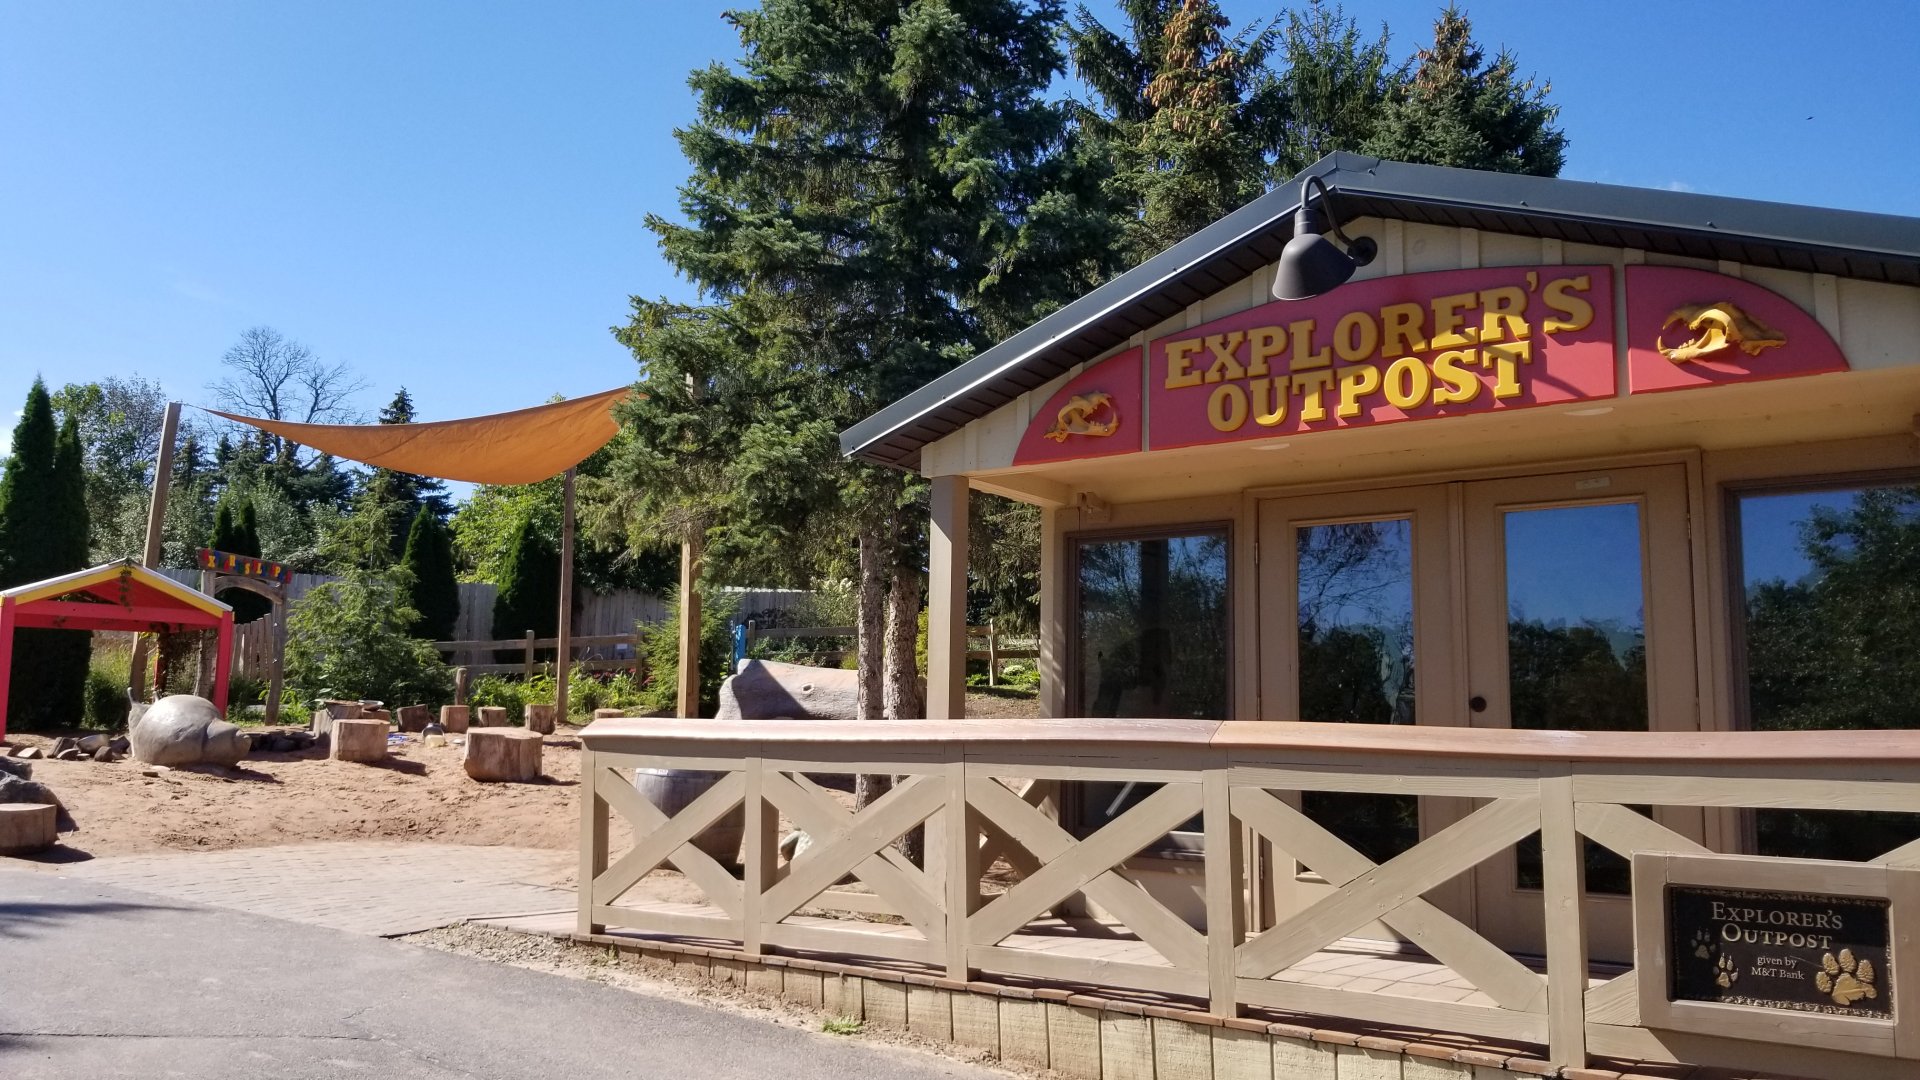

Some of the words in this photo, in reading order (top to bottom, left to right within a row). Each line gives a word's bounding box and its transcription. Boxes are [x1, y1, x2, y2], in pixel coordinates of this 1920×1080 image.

[1164, 271, 1596, 390] EXPLORER'S
[1206, 340, 1533, 433] OUTPOST
[1751, 966, 1778, 978] M&T
[1779, 969, 1805, 981] Bank
[1756, 955, 1783, 967] given
[1783, 956, 1798, 969] by
